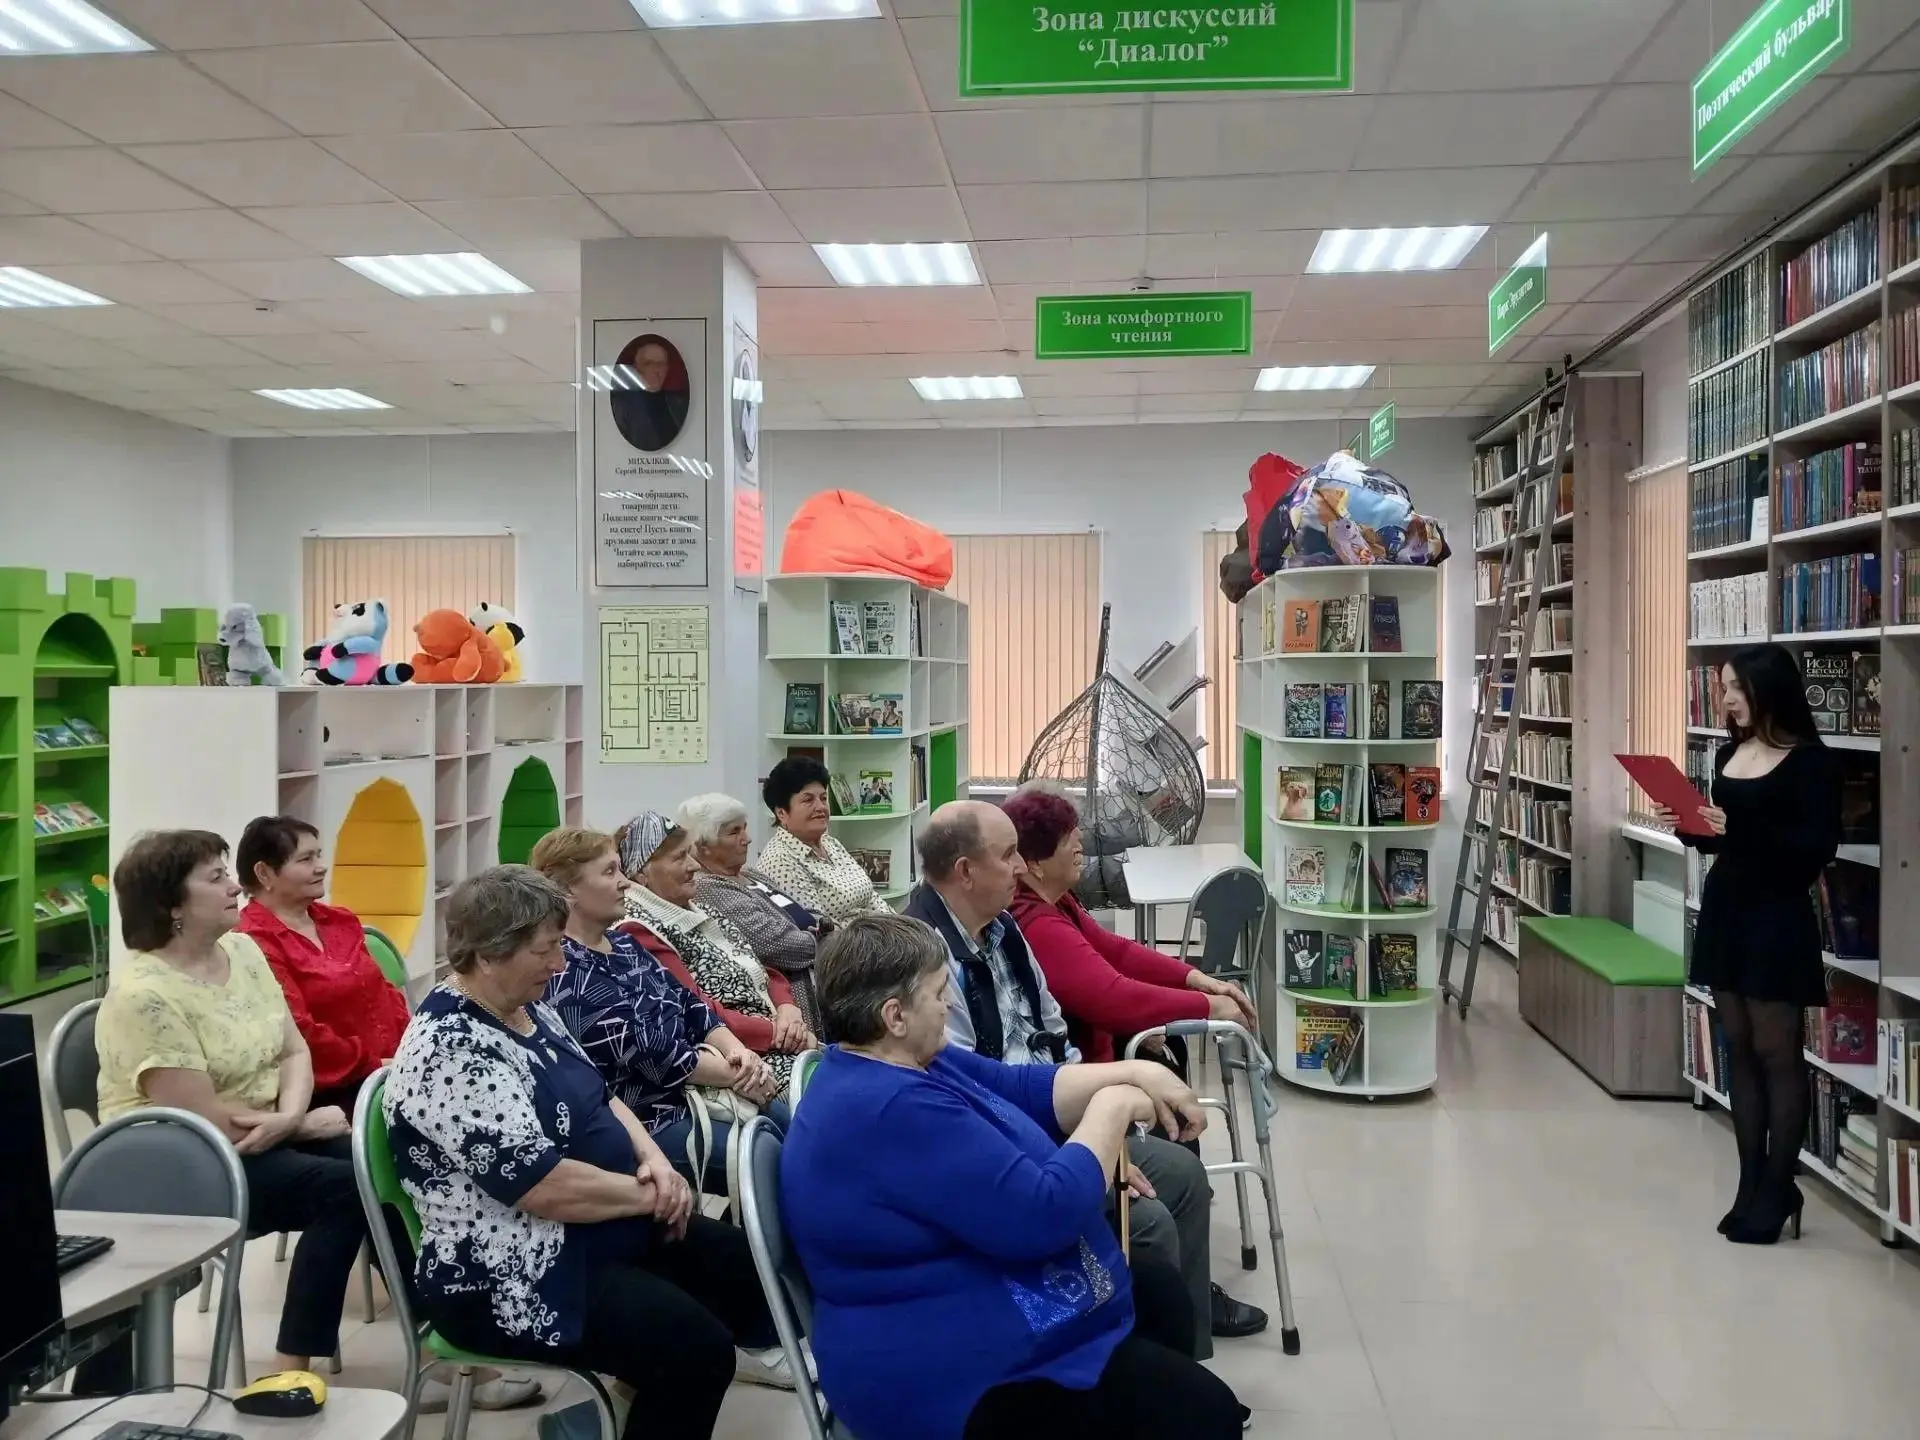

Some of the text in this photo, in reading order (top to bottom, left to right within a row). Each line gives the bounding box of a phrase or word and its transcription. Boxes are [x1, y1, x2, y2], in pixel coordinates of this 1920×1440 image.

[1032, 2, 1277, 34] Зона дискуссий
[1078, 35, 1229, 69] “Диалог”
[1697, 0, 1836, 131] Поэтический бульвар
[1062, 309, 1224, 327] Зона комфортного
[1111, 330, 1172, 344] чтения
[628, 457, 670, 465] МИХАЛКОВ
